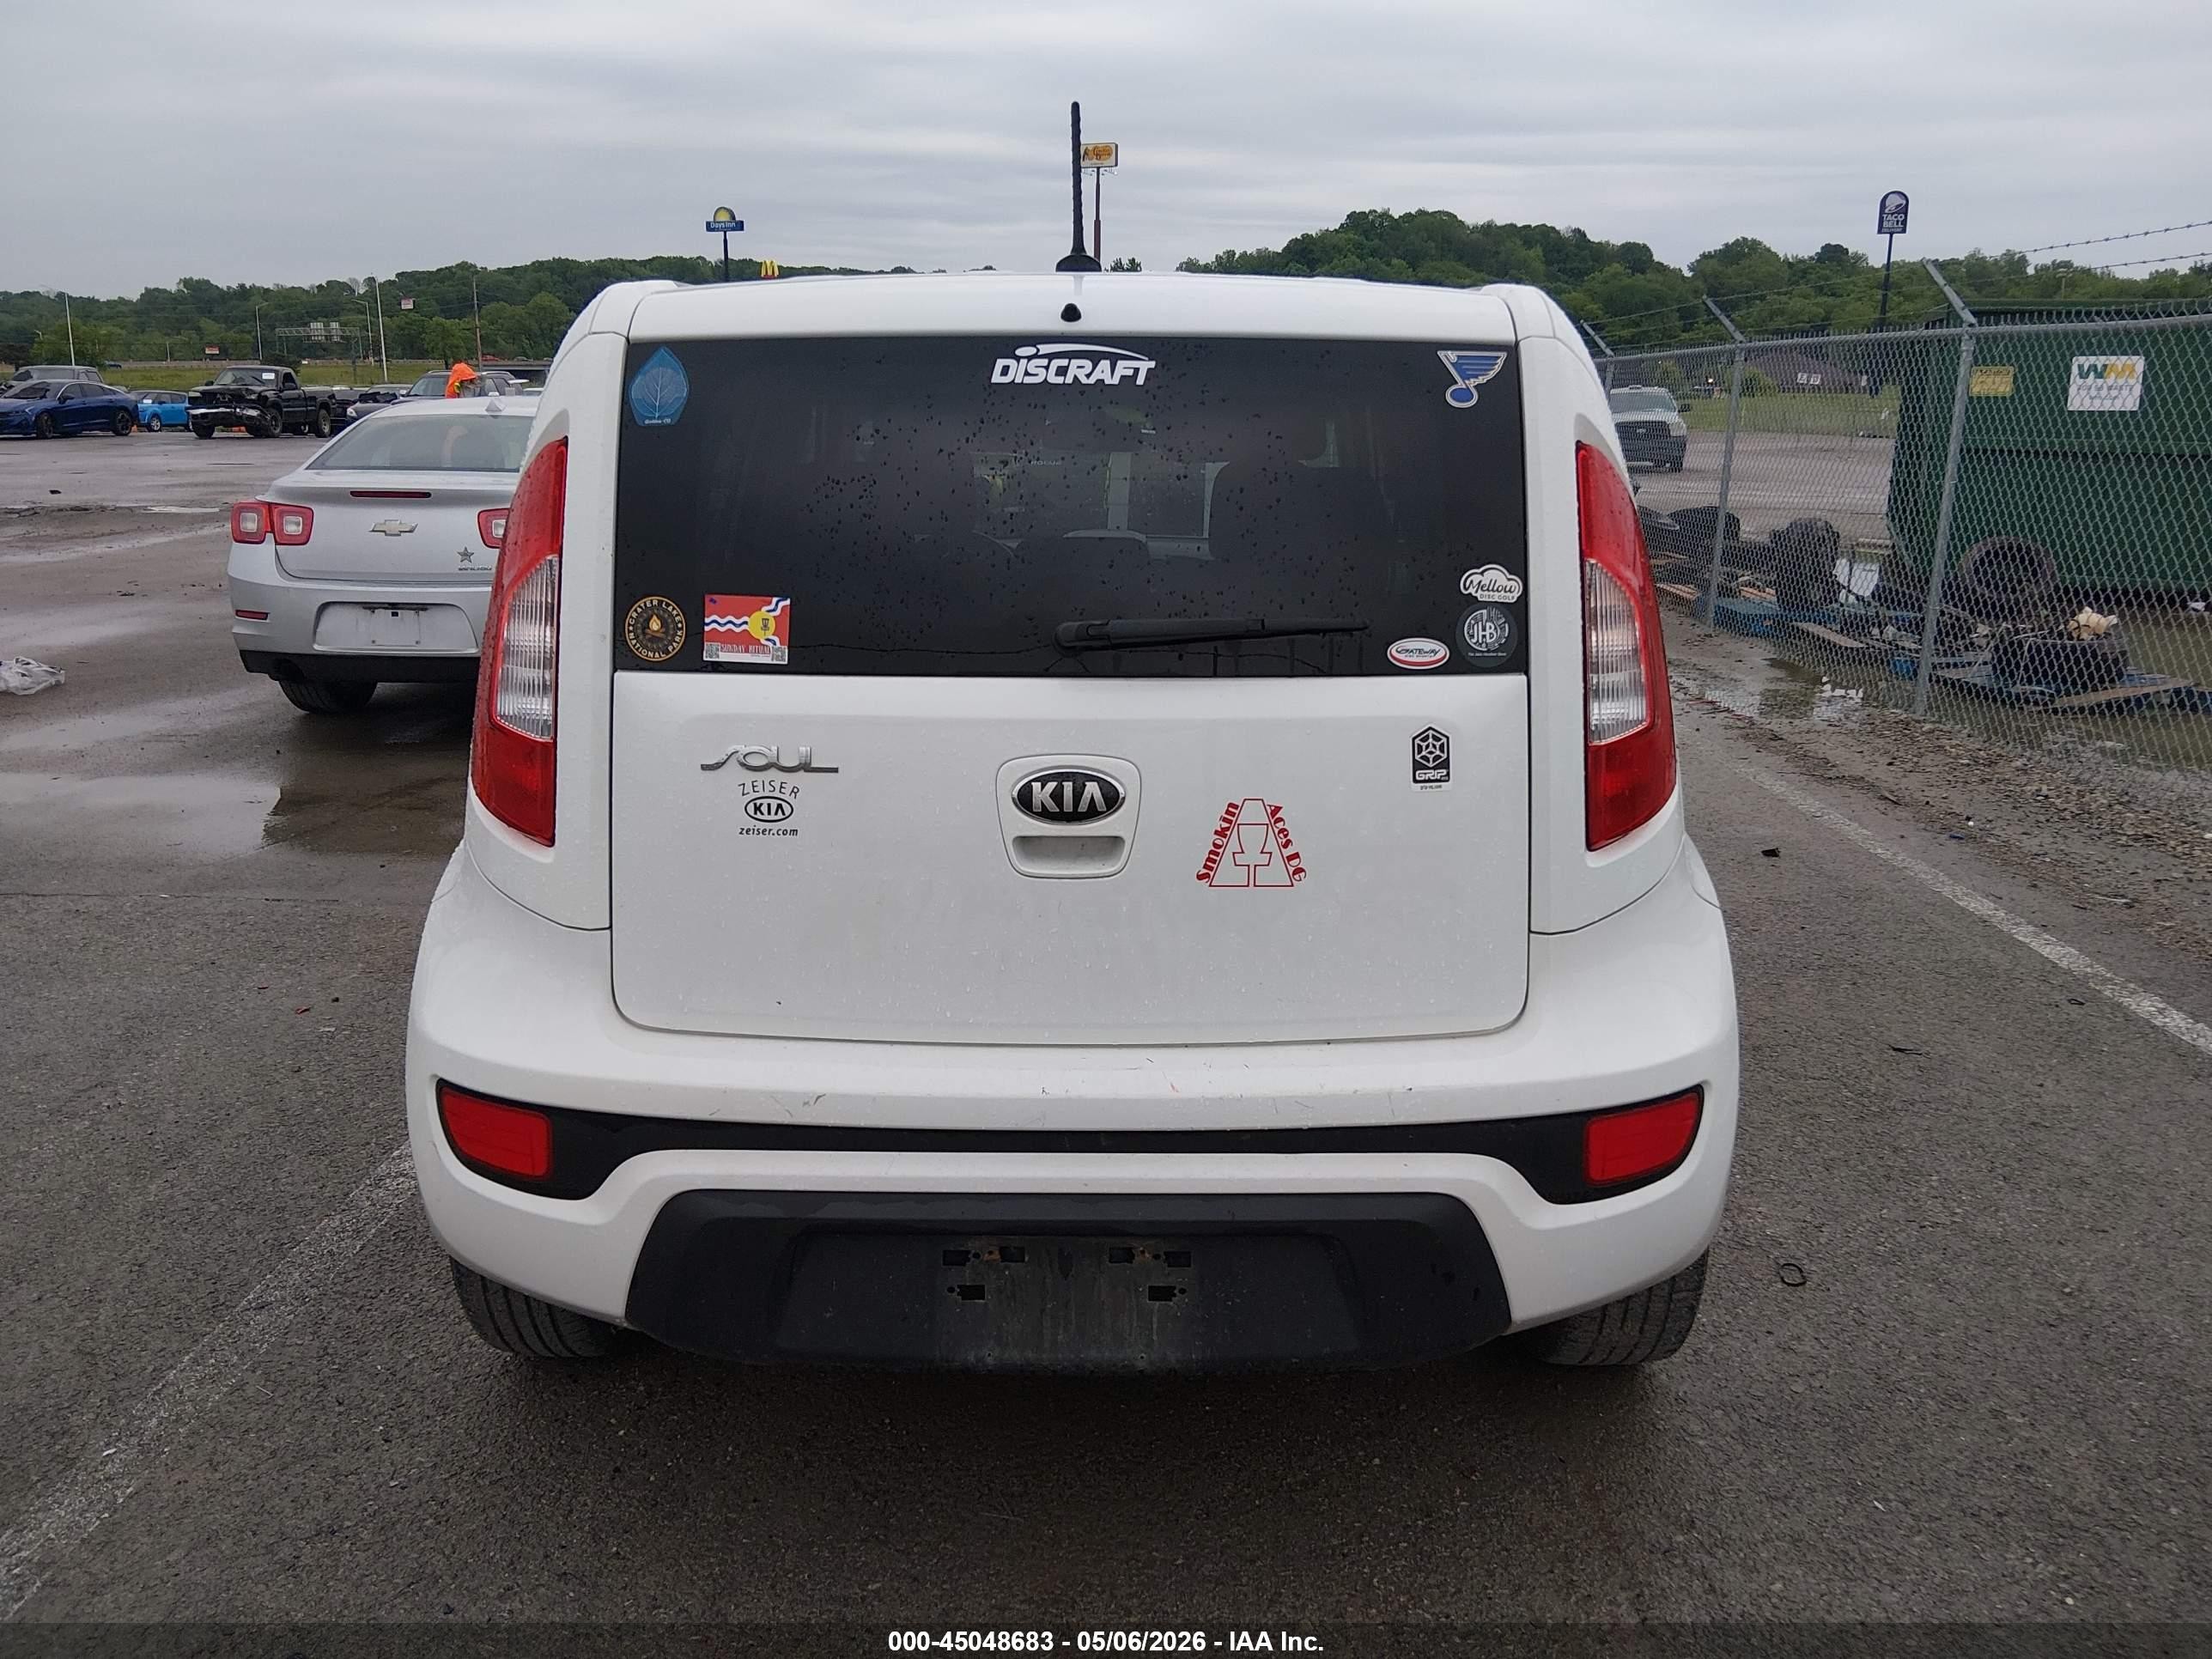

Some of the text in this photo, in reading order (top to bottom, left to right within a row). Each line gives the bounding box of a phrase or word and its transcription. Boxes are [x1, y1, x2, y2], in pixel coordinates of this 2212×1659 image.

[2077, 363, 2136, 379] WM
[1465, 578, 1516, 593] Mellow
[629, 599, 682, 625] CRATER LAKE
[629, 630, 684, 659] NATIONAL PARK
[738, 780, 800, 799] ZEISER
[1031, 781, 1107, 812] KIA
[753, 803, 786, 816] KIA
[738, 825, 799, 836] zeiser.com
[1267, 804, 1293, 849] Aces
[1196, 802, 1239, 884] Smokin
